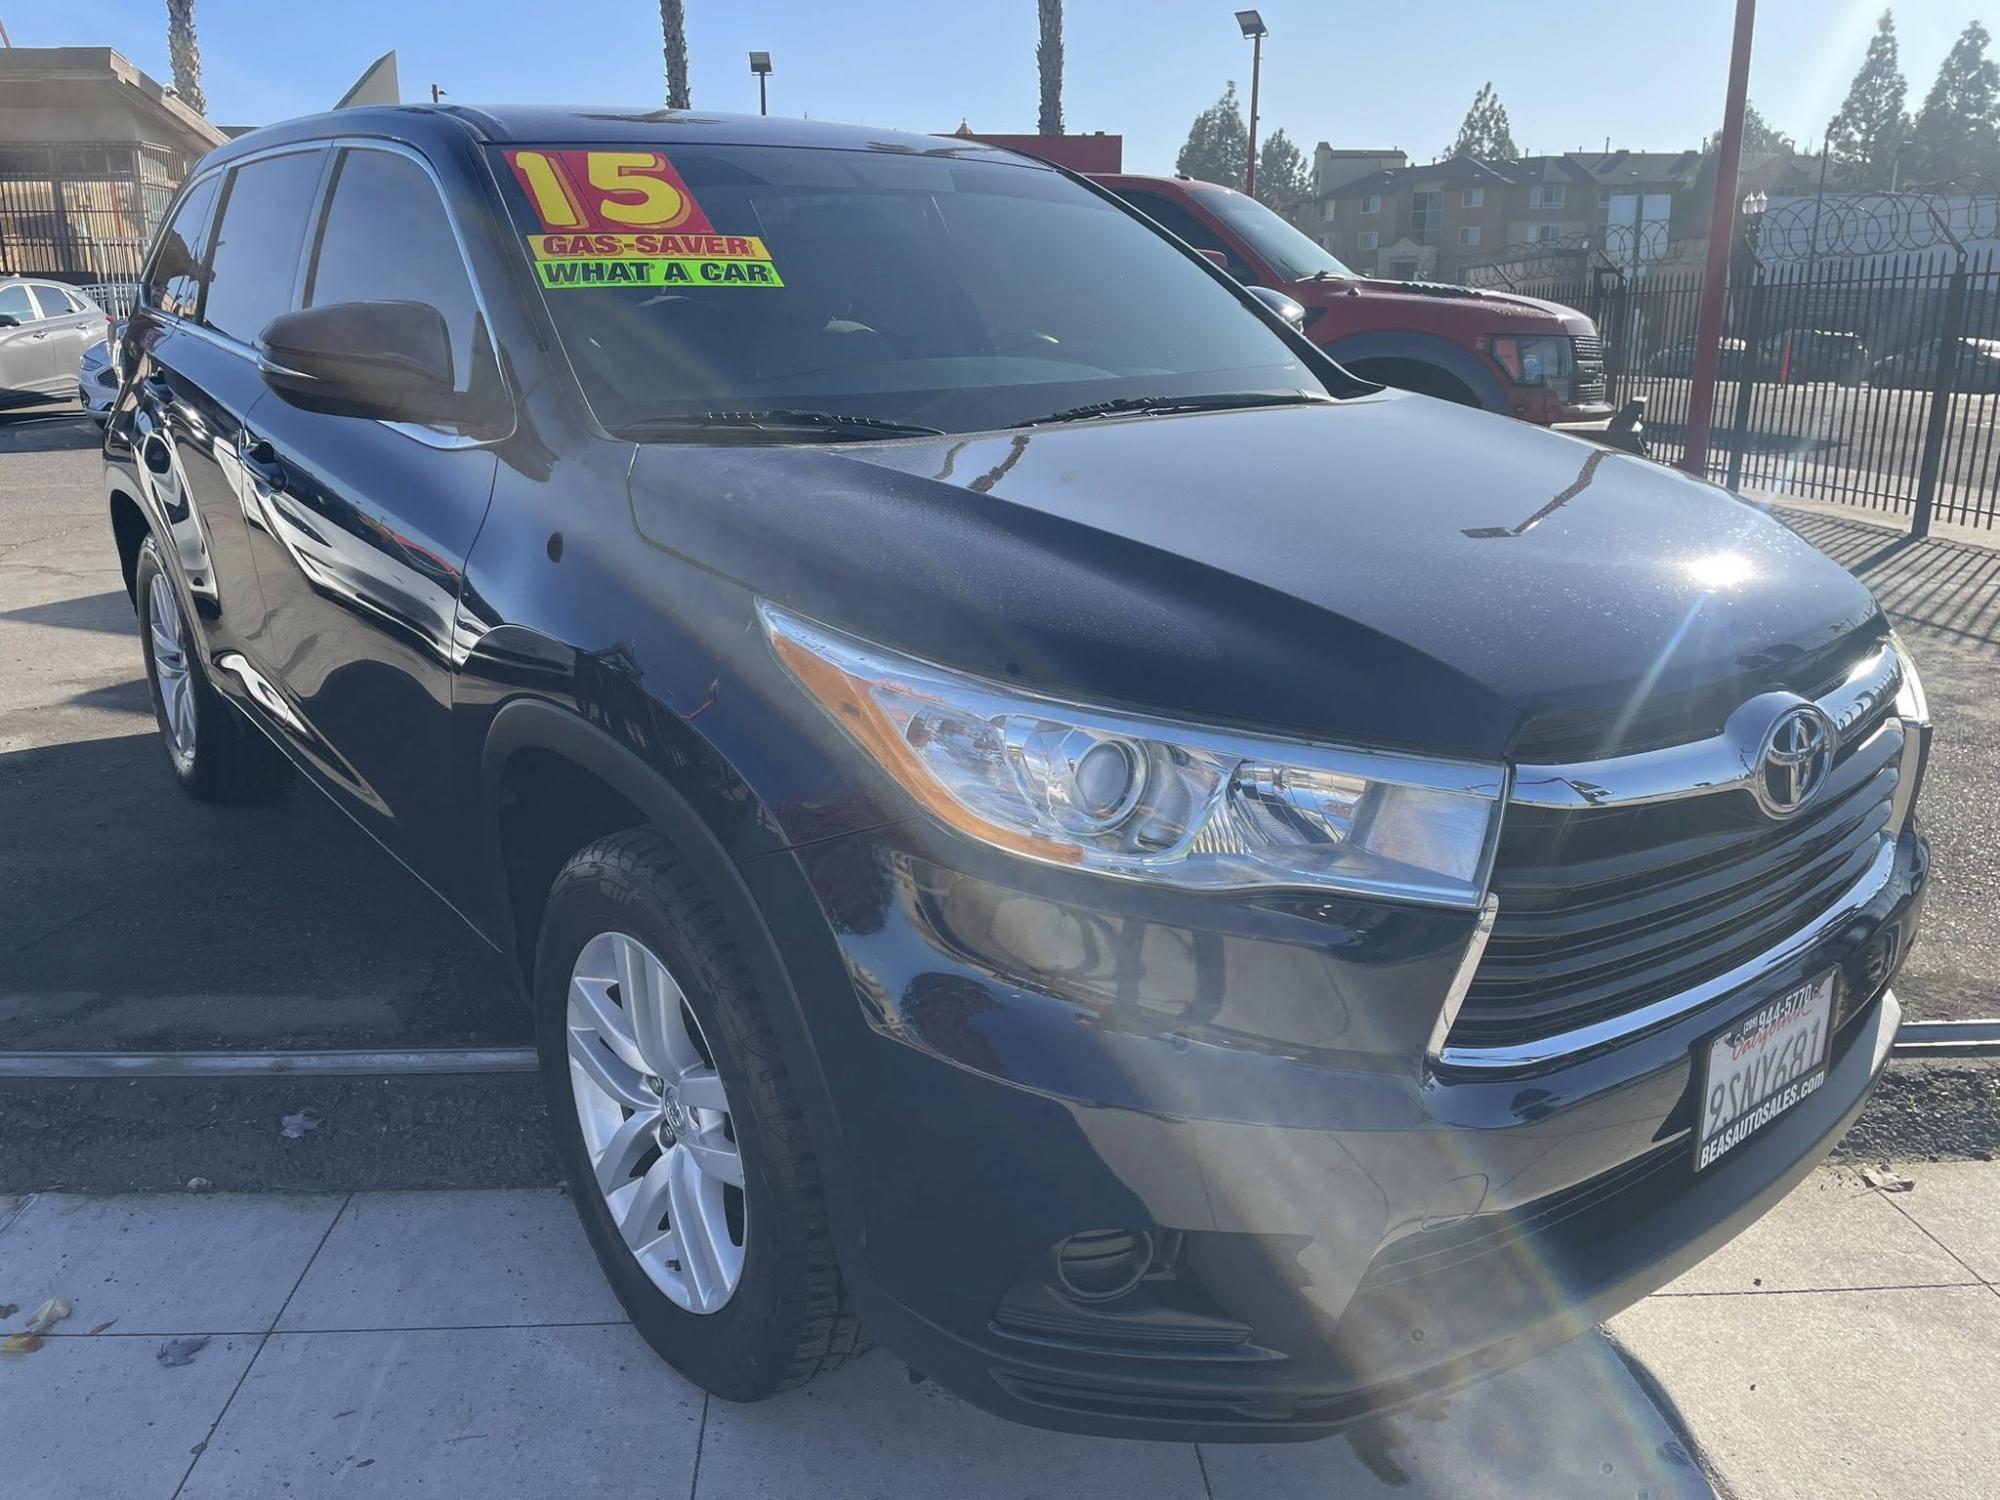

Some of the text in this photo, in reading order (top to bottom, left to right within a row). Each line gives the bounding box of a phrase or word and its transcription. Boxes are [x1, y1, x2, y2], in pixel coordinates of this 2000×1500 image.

[515, 151, 691, 229] 15
[543, 235, 755, 257] GAS-SAVER
[543, 262, 769, 285] WHAT A CAR
[1758, 983, 1813, 1030] 944-5770
[1709, 1017, 1821, 1133] 9SNY681
[1700, 1070, 1825, 1169] BEASAUTOSALES.com
